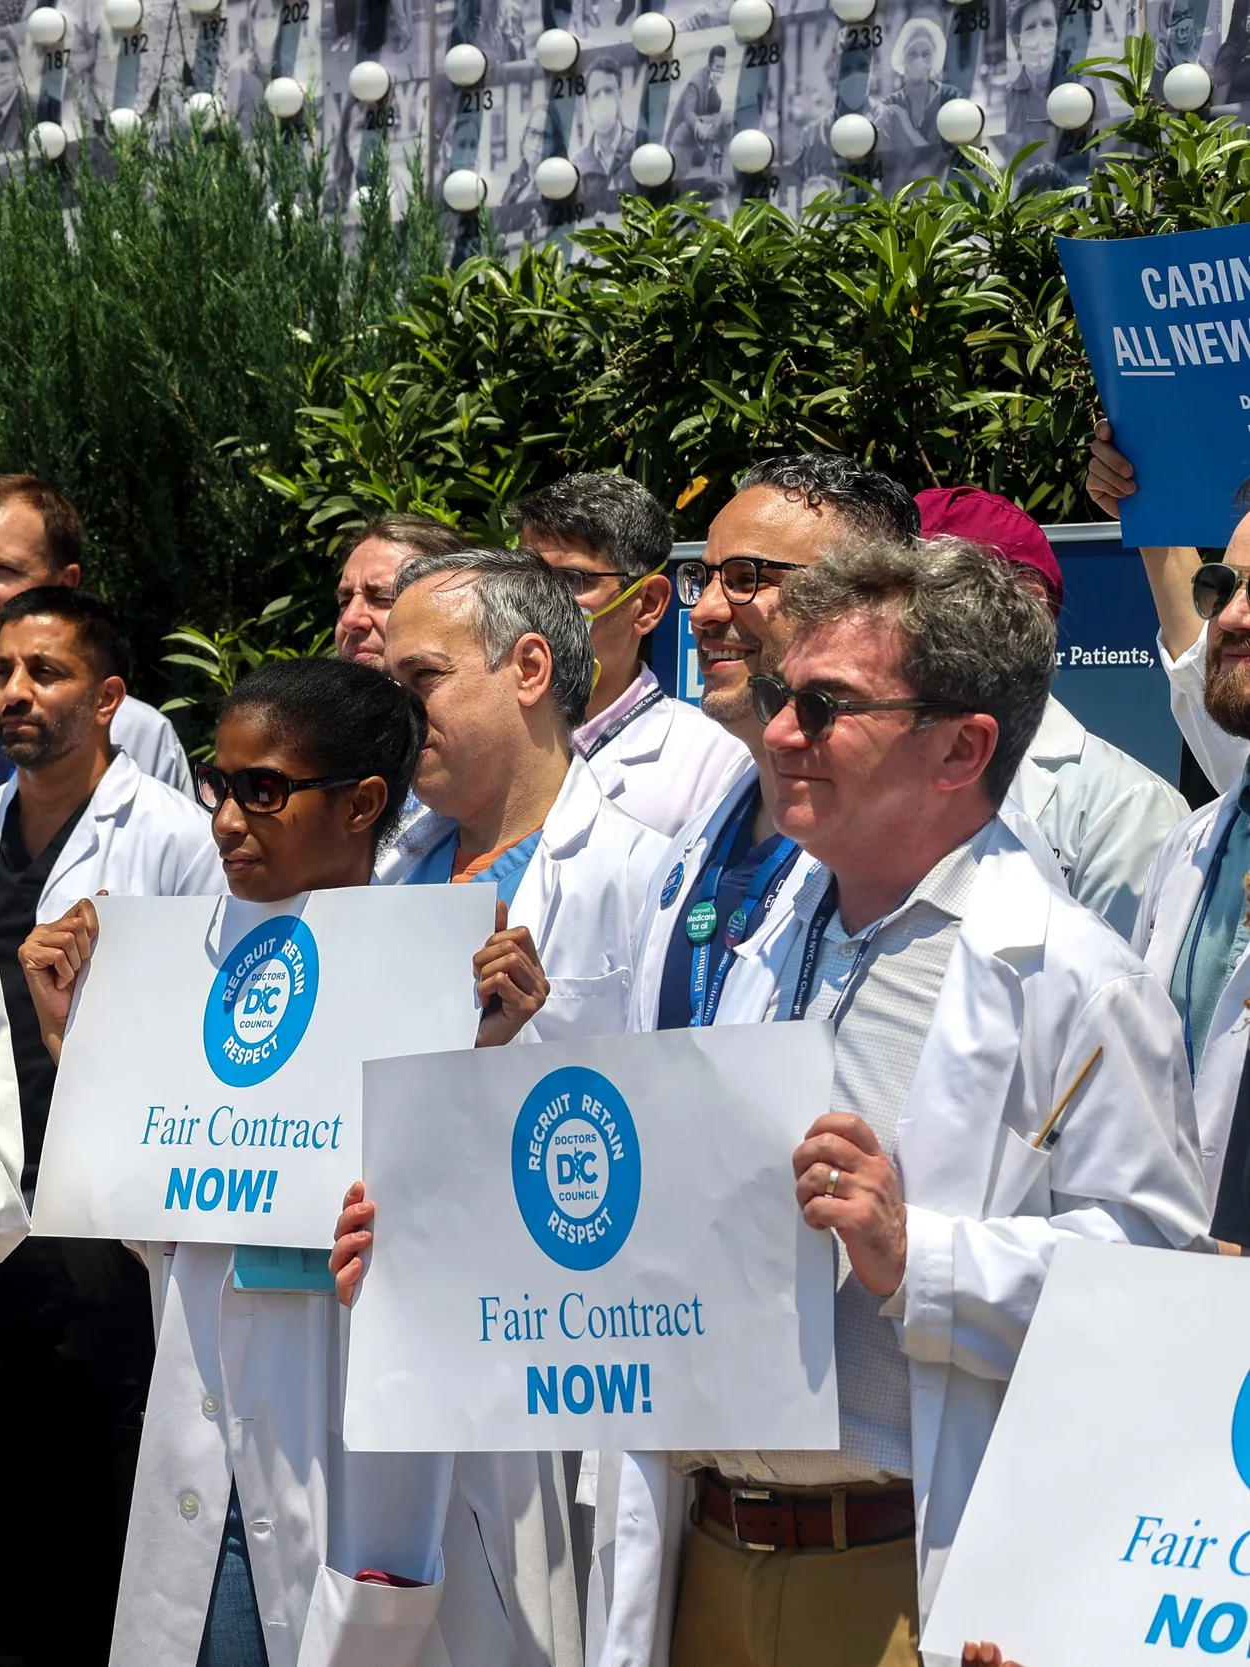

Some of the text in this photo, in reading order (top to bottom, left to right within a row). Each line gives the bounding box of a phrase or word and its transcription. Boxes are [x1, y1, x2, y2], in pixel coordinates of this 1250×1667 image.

[282, 3, 310, 25] 202
[953, 8, 990, 34] 238
[201, 18, 227, 40] 197
[848, 25, 883, 50] 233
[123, 34, 149, 55] 192
[46, 49, 71, 71] 187
[745, 45, 780, 68] 228
[648, 60, 681, 84] 223
[554, 74, 586, 99] 218
[462, 90, 494, 113] 213
[1141, 256, 1250, 310] CARIN
[1112, 319, 1250, 366] ALL NEW
[1070, 646, 1155, 668] Patients,
[687, 914, 716, 923] Medicare
[700, 922, 708, 930] all
[811, 928, 820, 939] an
[806, 941, 817, 961] NYC
[222, 937, 306, 1002] RECRUIT RETAIN
[251, 972, 286, 982] DOCTORS
[803, 961, 812, 979] Vax
[239, 1020, 274, 1029] COUNCIL
[222, 1034, 279, 1065] RESPECT
[140, 1105, 344, 1150] Fair Contract
[528, 1093, 625, 1171] RECRUIT RETAIN
[554, 1133, 597, 1145] DOCTORS
[164, 1167, 278, 1214] NOW!
[558, 1190, 599, 1201] COUNCIL
[547, 1207, 613, 1245] RESPECT
[477, 1292, 706, 1342] Fair Contract
[526, 1363, 653, 1415] NOW!
[1118, 1515, 1218, 1570] Fair
[1144, 1593, 1250, 1660] NO
